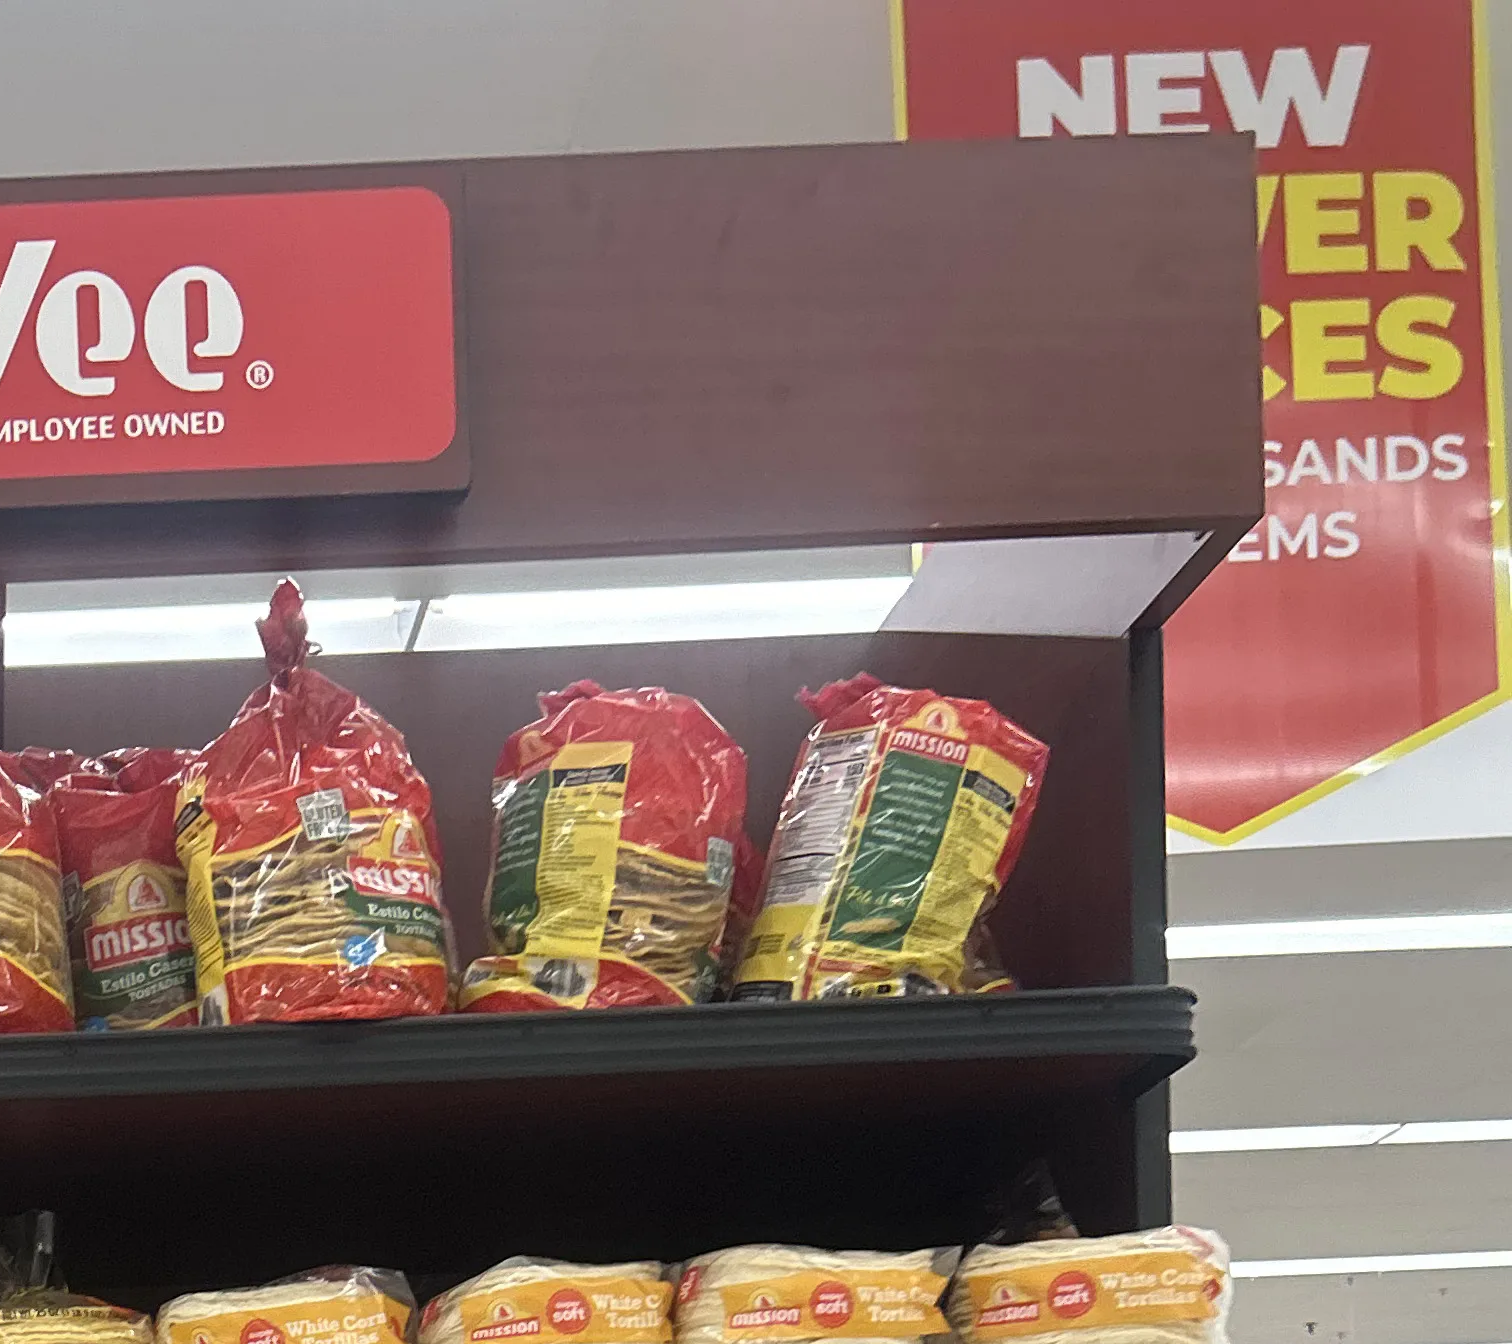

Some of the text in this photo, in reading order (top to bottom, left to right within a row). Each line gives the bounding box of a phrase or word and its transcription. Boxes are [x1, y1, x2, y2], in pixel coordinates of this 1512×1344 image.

[1016, 44, 1370, 148] NEW
[1256, 171, 1466, 274] ER
[124, 410, 225, 438] OWNED
[286, 1312, 386, 1337] White Corn
